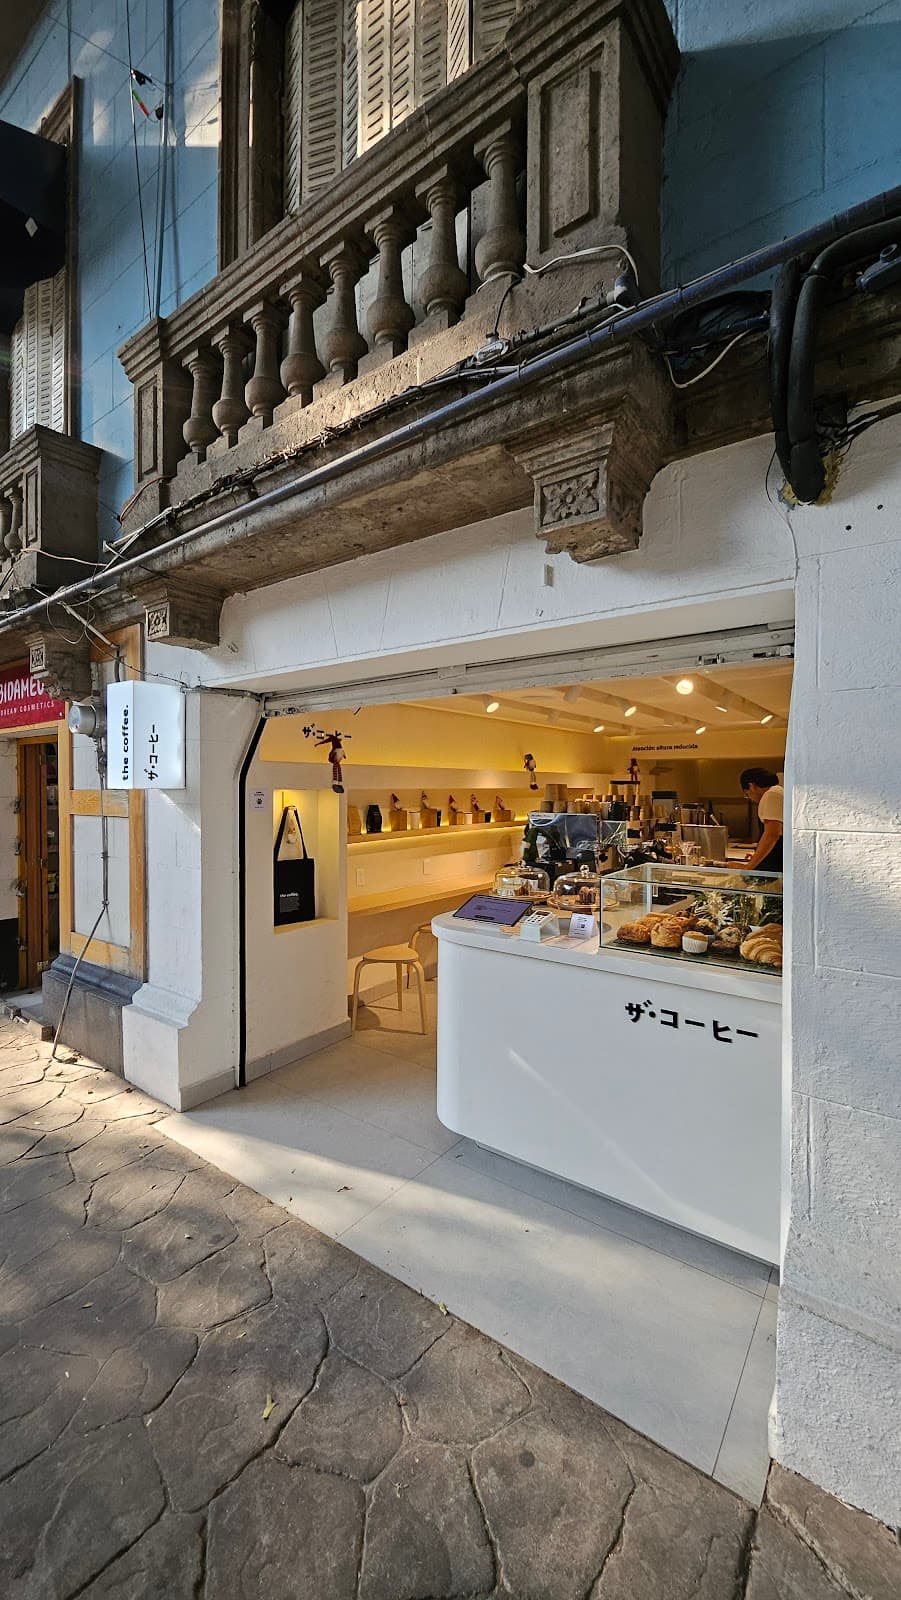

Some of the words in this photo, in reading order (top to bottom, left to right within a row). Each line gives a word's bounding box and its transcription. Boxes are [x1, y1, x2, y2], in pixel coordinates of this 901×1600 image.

[19, 700, 55, 713] COSMETICS
[143, 724, 159, 781] ザ・コーヒー
[625, 999, 759, 1044] ザ・コーヒー
